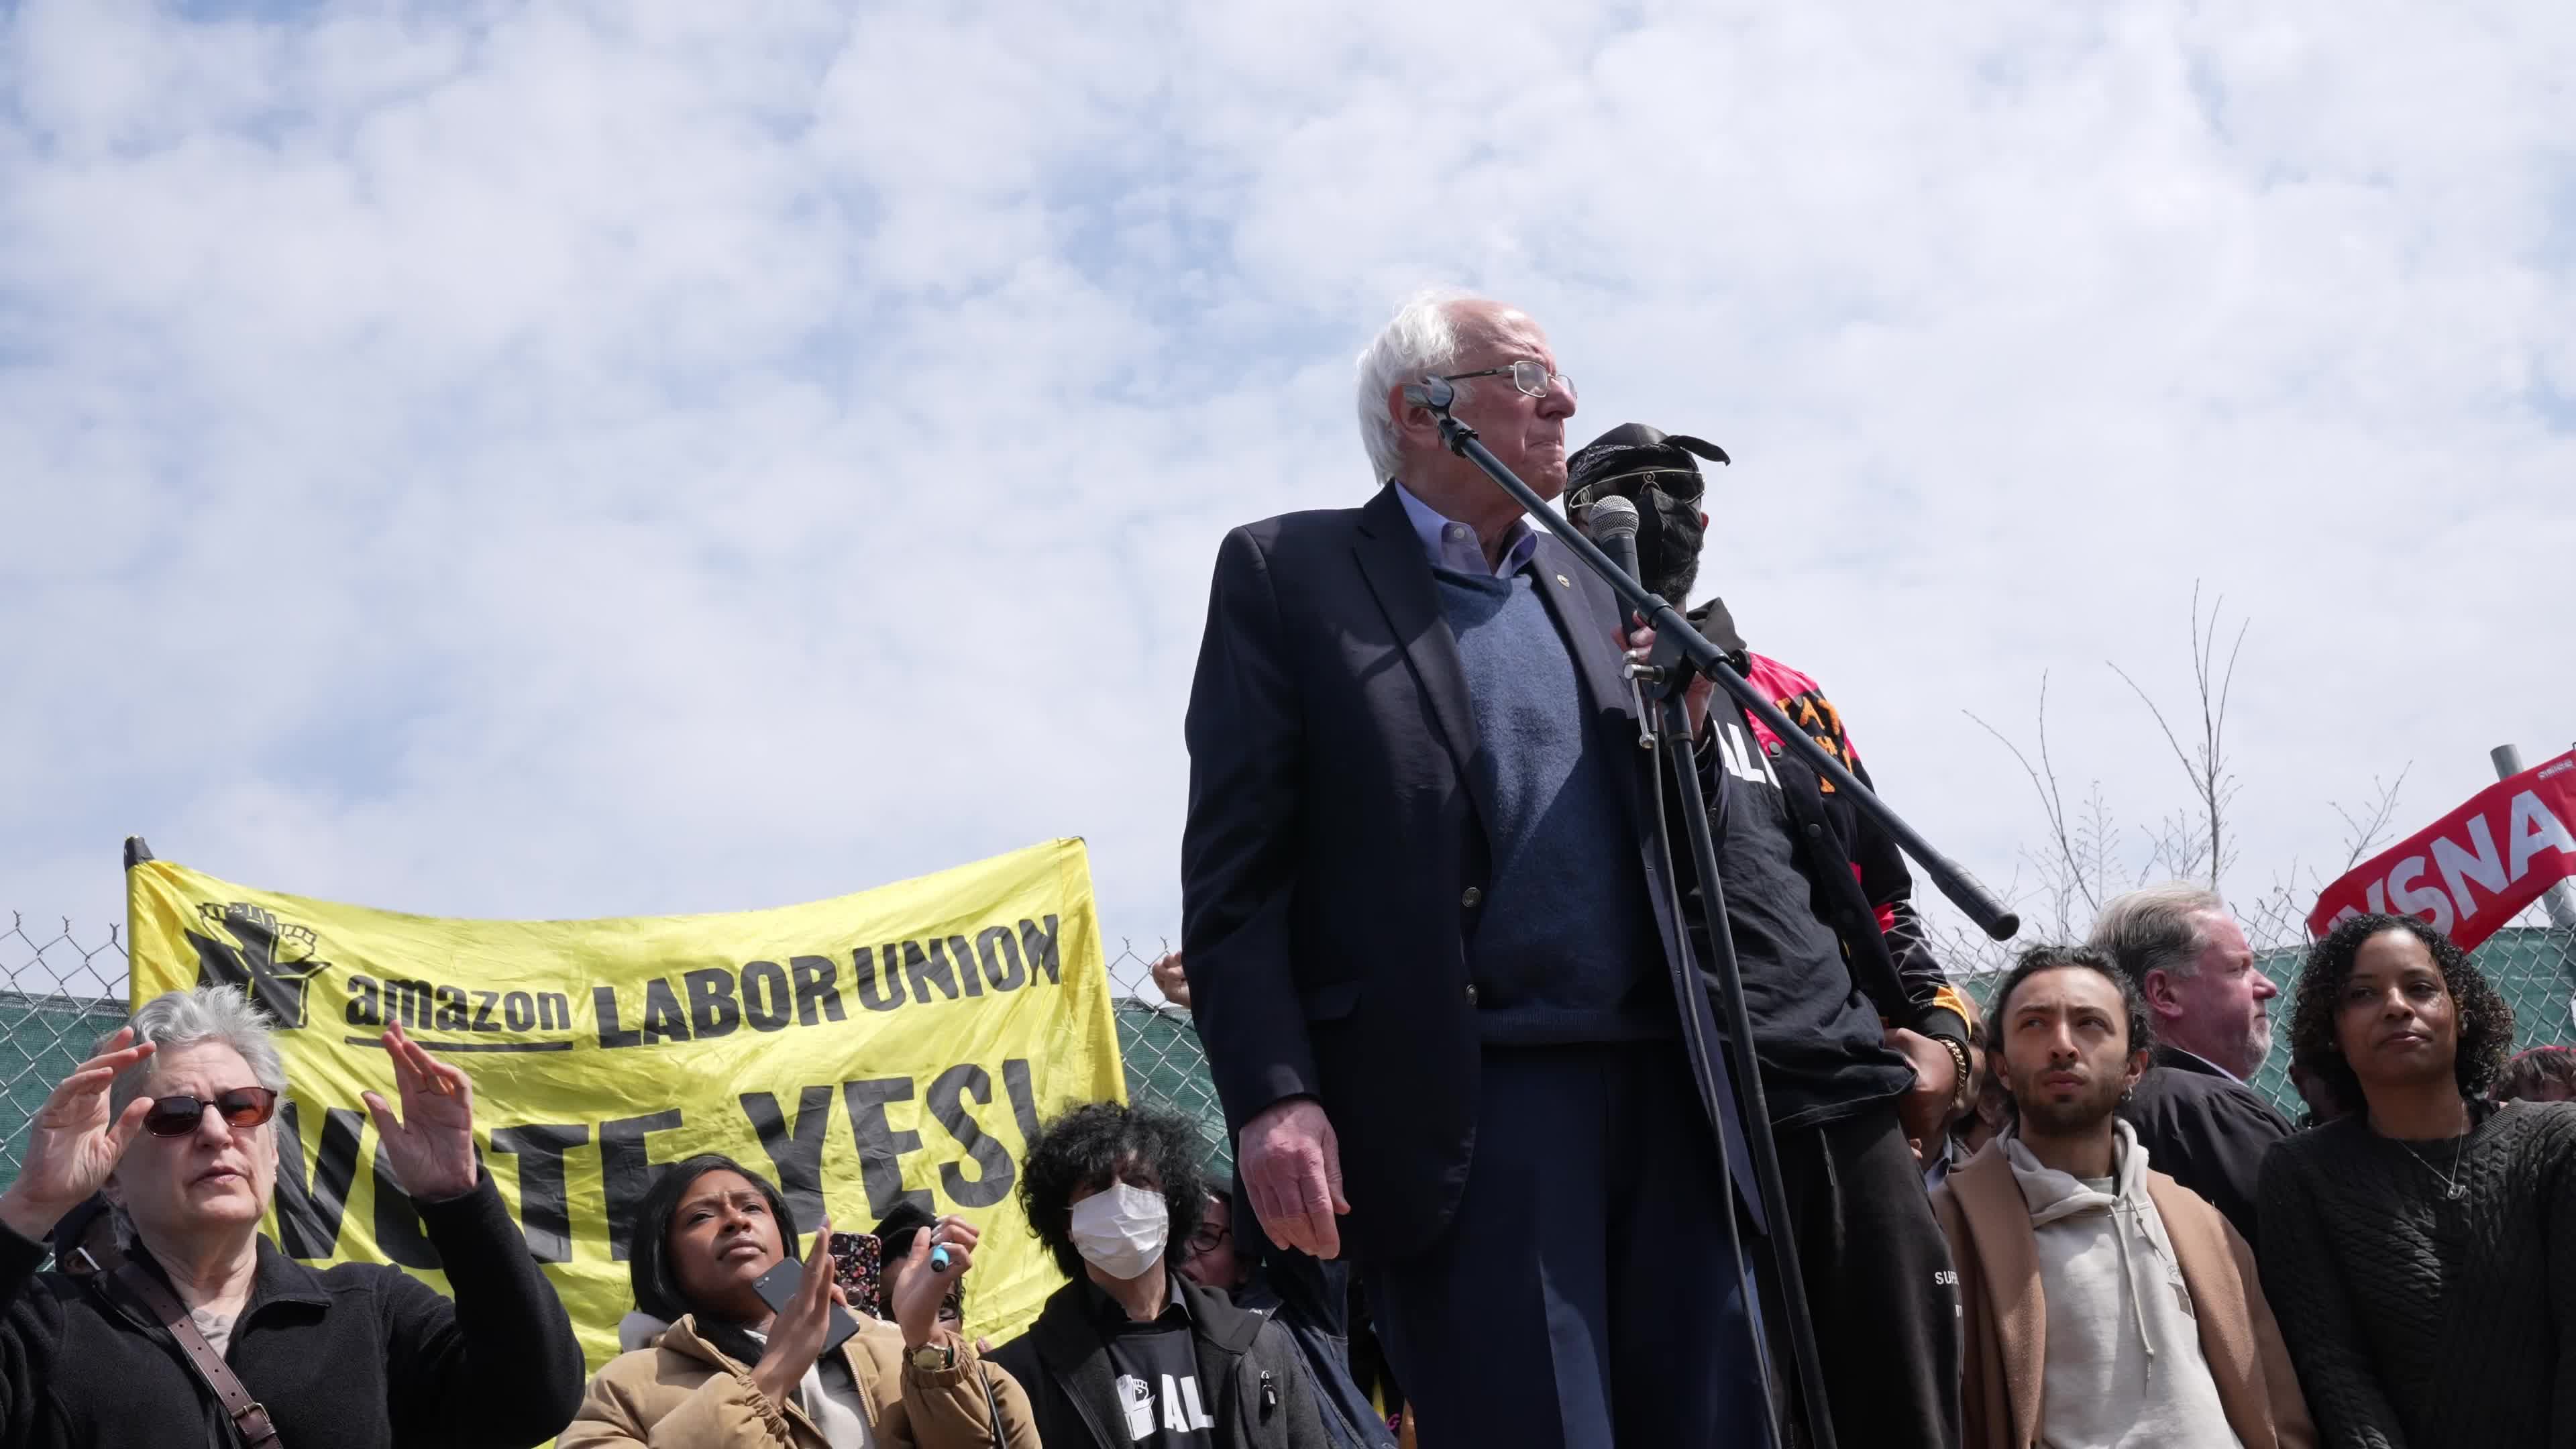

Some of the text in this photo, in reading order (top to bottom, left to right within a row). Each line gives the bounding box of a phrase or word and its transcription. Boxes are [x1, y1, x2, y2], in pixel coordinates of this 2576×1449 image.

[345, 914, 1061, 1049] amazon LABOR UNION
